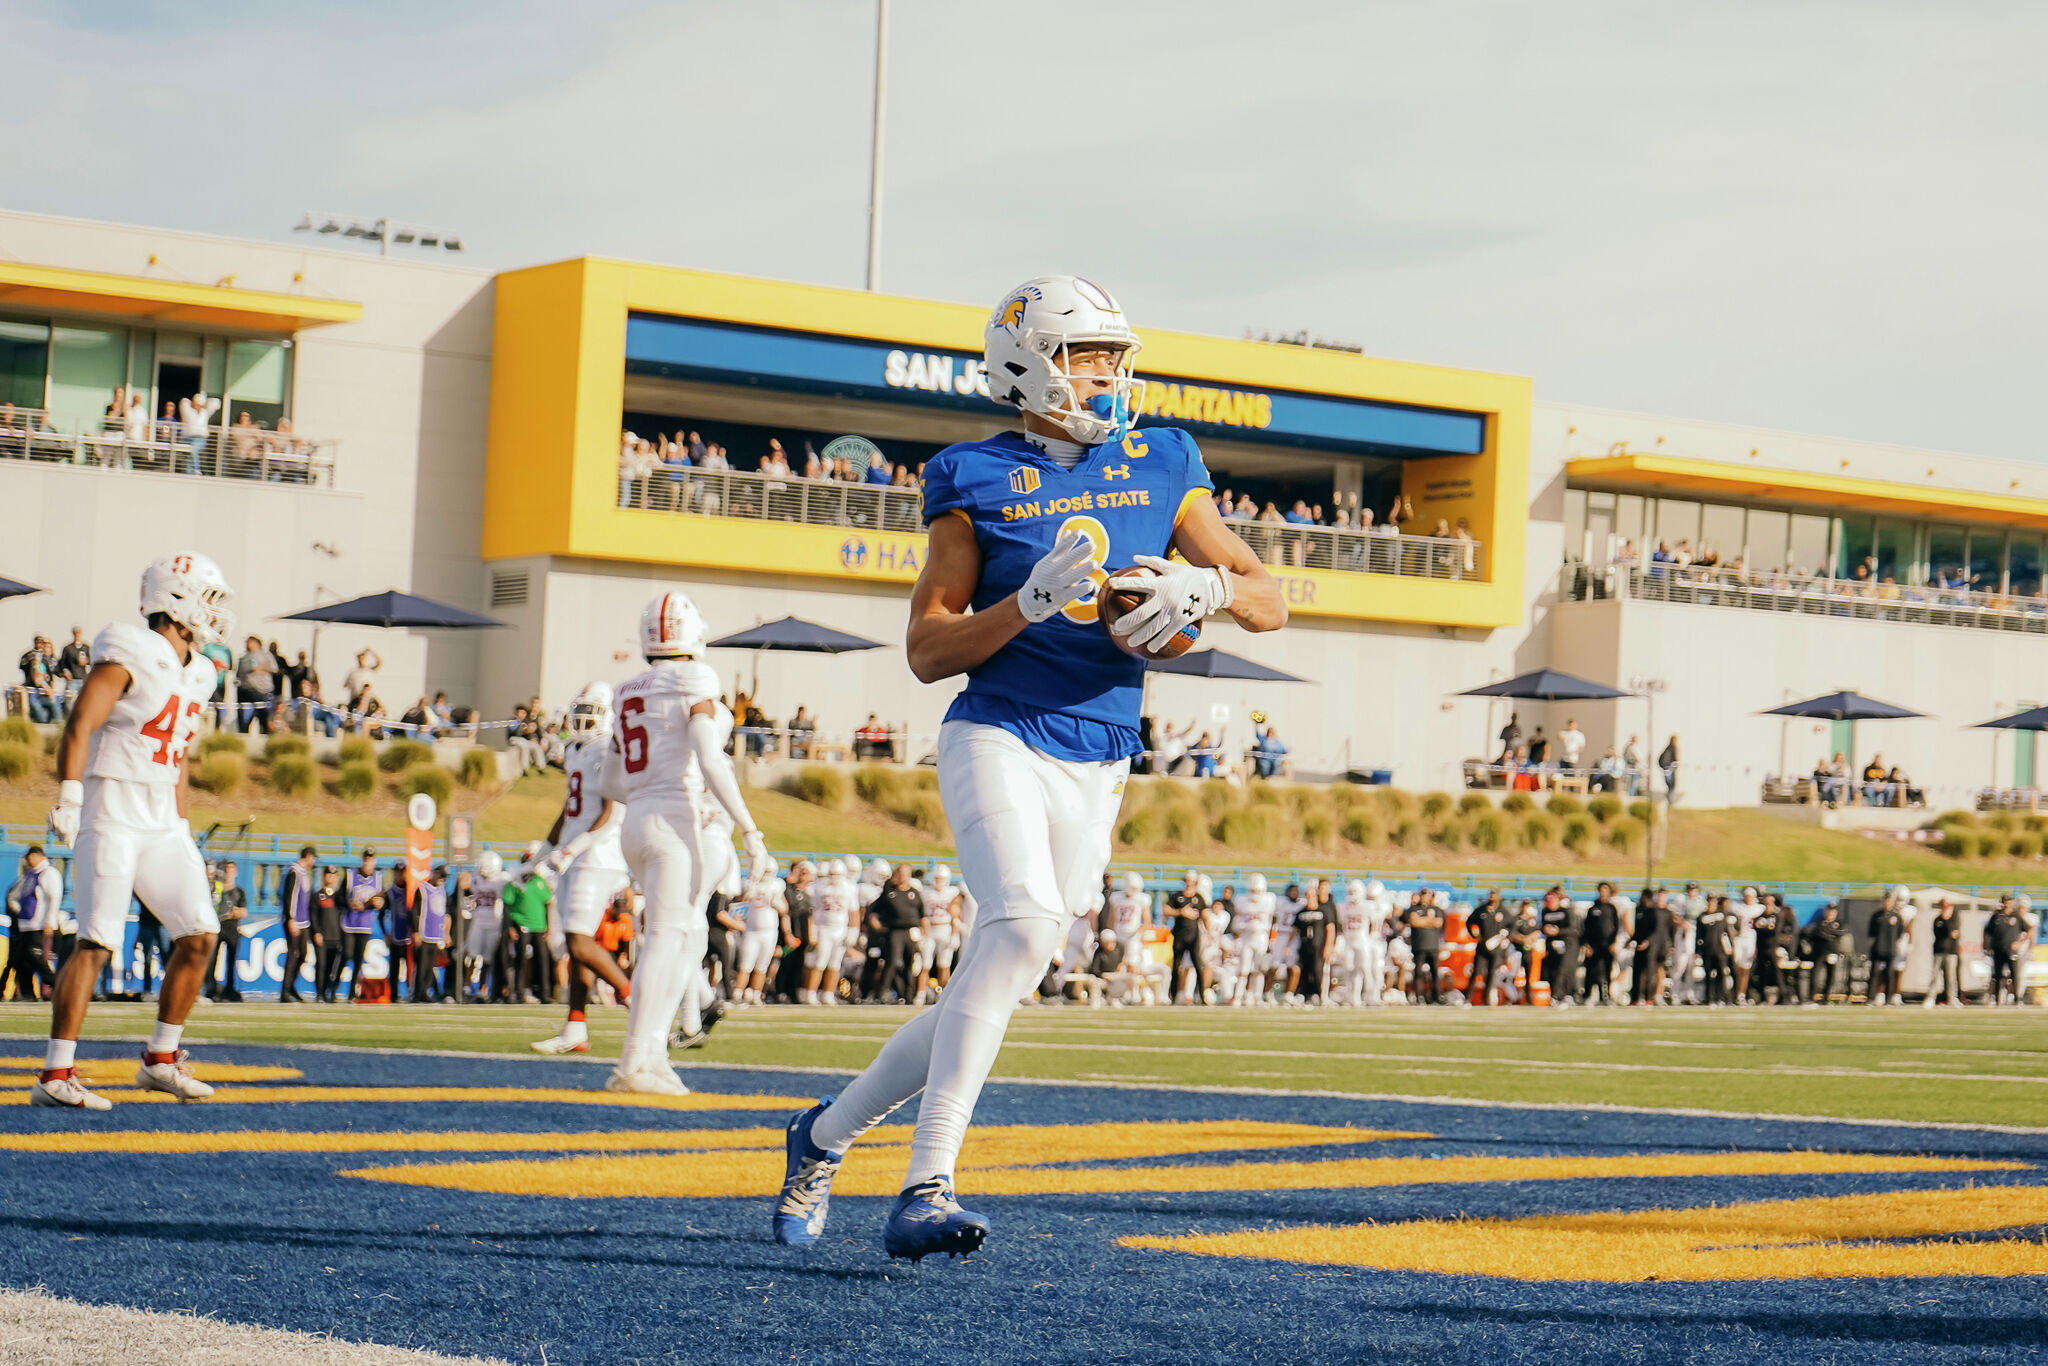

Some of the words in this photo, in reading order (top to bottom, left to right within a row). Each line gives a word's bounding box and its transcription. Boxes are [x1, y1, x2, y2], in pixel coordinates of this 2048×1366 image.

[885, 350, 953, 392] SAN
[1130, 379, 1272, 429] SPARTANS
[1122, 430, 1149, 458] C
[1001, 501, 1042, 522] SAN
[1043, 491, 1094, 515] JOSÉ
[1096, 490, 1150, 508] STATE
[878, 543, 929, 571] HA
[621, 697, 648, 774] 6
